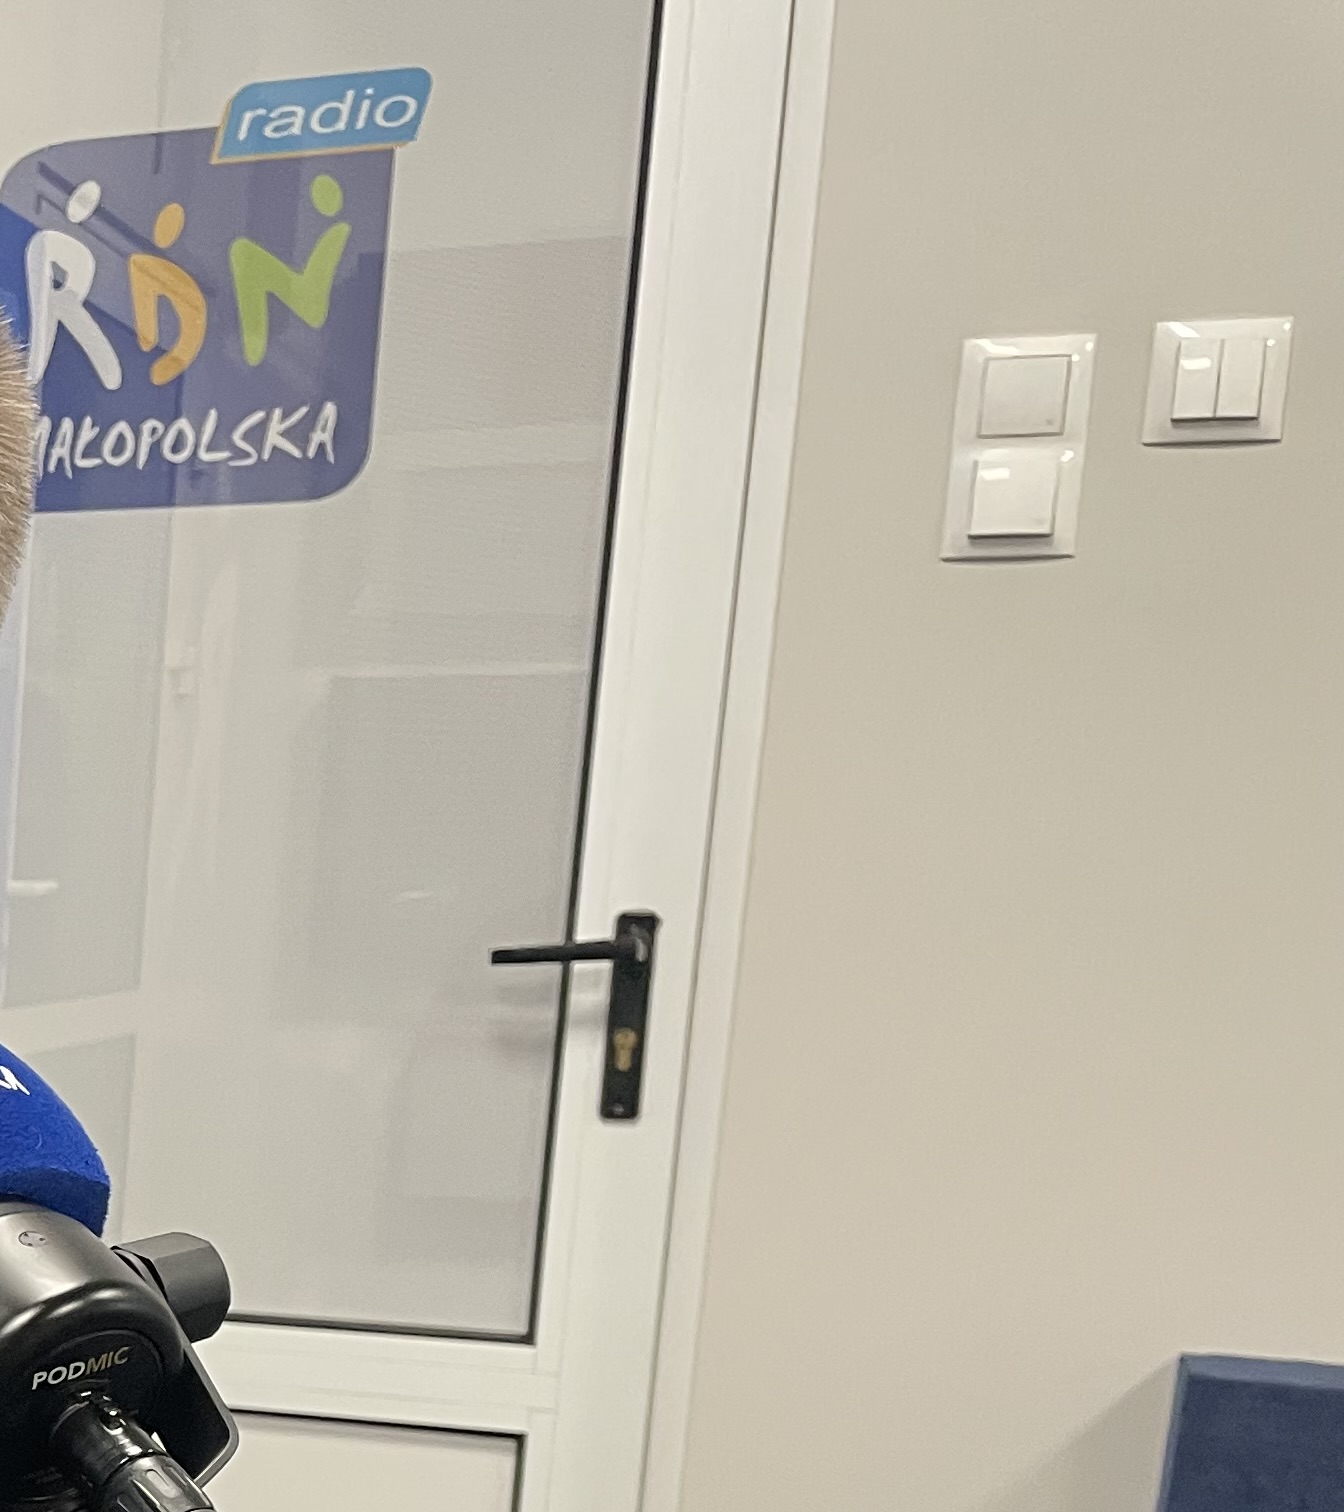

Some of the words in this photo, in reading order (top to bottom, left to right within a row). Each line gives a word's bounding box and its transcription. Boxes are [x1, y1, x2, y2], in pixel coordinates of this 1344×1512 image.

[237, 87, 418, 142] radio
[24, 175, 351, 391] RDN
[31, 1346, 130, 1390] PODMIC
